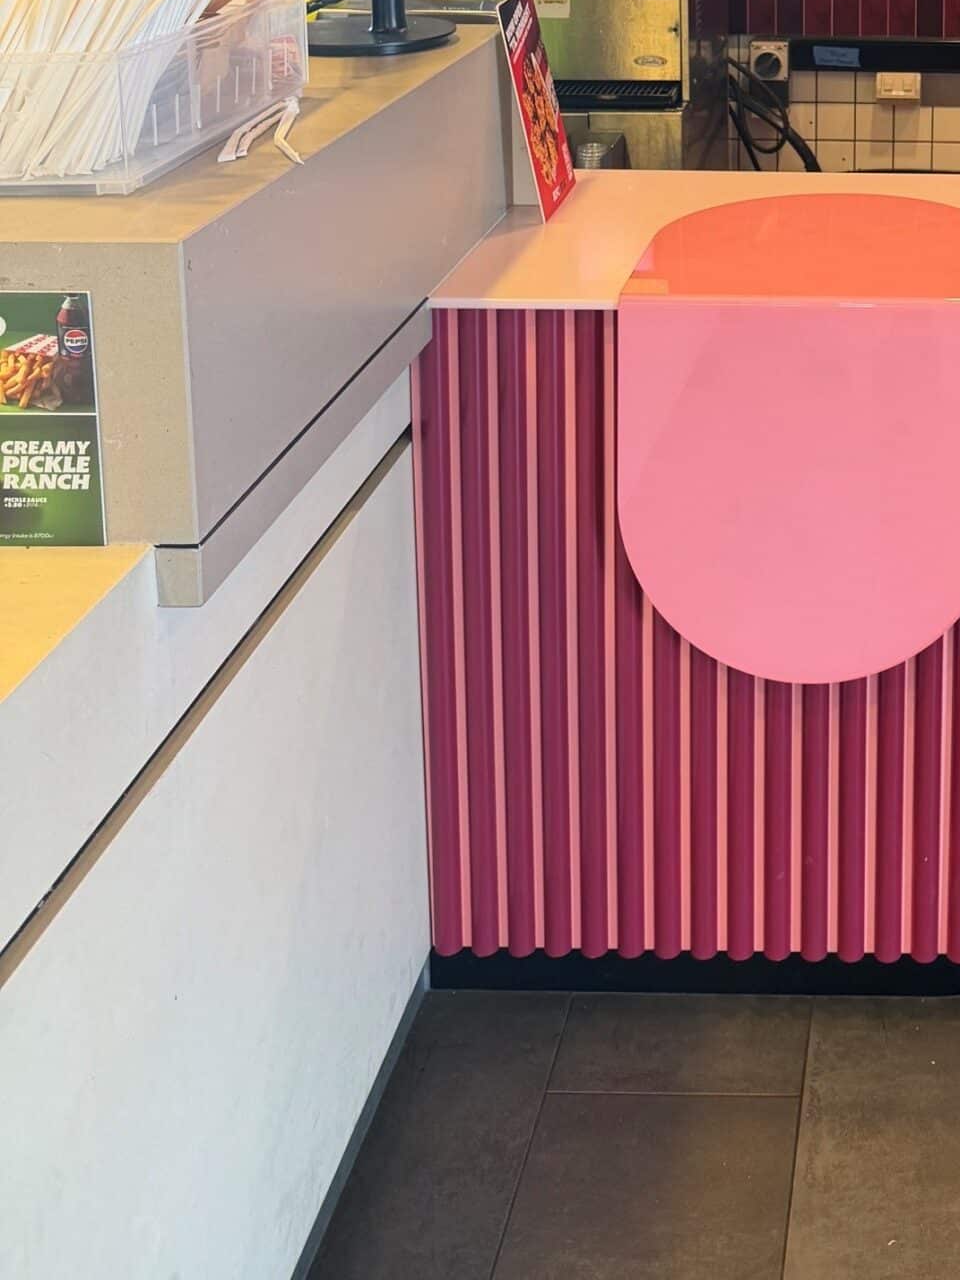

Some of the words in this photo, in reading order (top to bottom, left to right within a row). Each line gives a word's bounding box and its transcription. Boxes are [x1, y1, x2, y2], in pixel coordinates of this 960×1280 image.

[1, 440, 91, 455] CREAMY
[2, 455, 91, 473] PICKLE
[3, 473, 91, 490] RANCH
